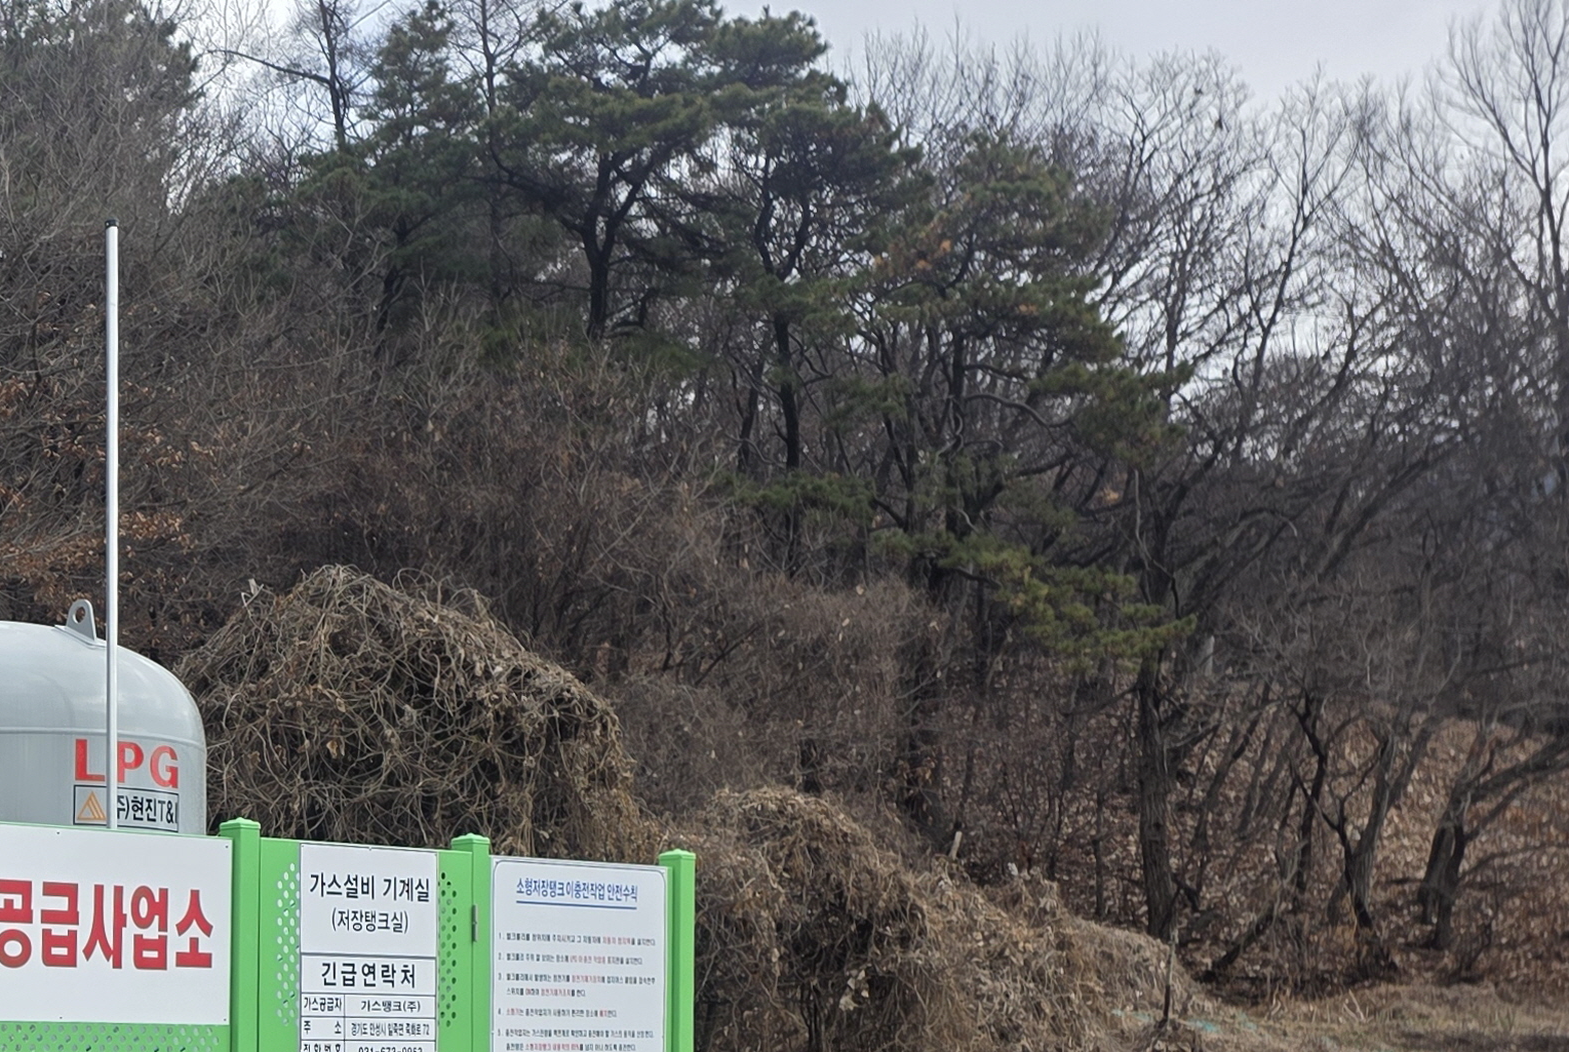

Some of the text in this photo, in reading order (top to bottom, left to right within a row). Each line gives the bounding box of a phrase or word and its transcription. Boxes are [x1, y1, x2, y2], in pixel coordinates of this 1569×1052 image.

[74, 738, 179, 789] LPG
[117, 795, 178, 824] 주)현진T&I
[310, 872, 429, 902] 가스설비 기계실
[331, 907, 408, 934] (저장탱크실)
[321, 961, 415, 988] 긴급연락처
[303, 997, 342, 1012] 가스공급자
